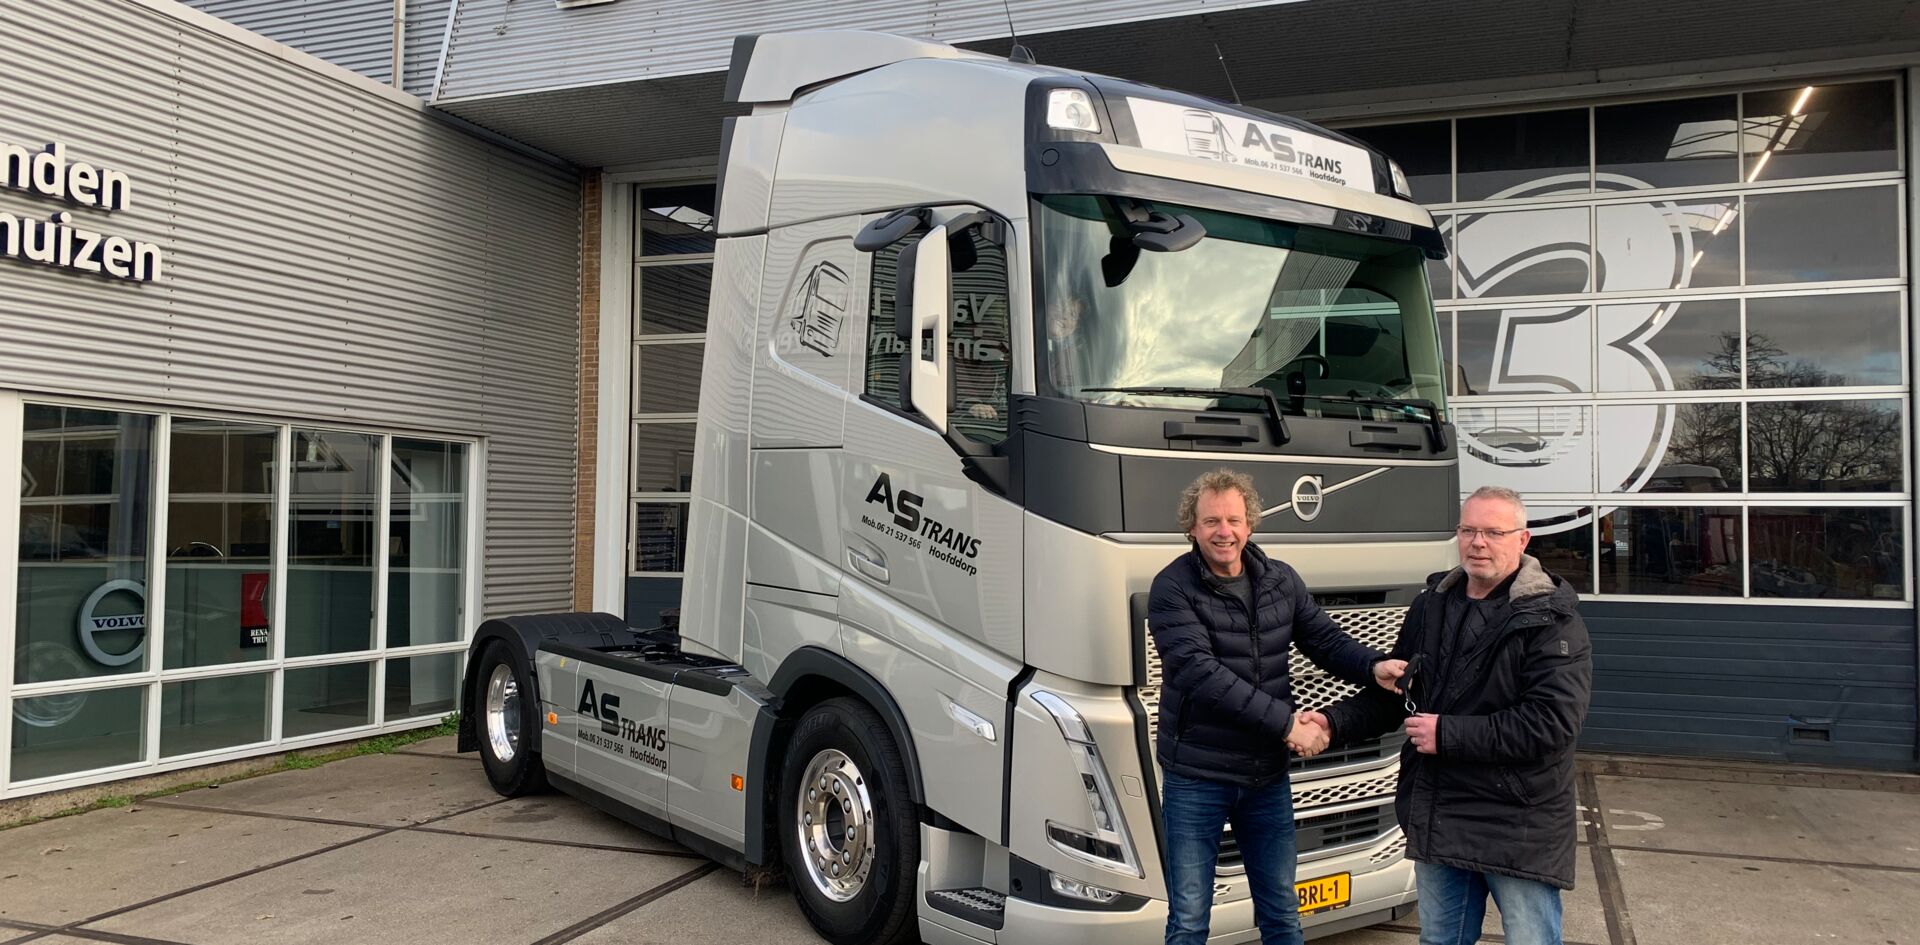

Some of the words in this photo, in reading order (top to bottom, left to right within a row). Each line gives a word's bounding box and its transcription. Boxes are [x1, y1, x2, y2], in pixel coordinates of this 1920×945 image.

[0, 142, 131, 210] nden
[1309, 170, 1346, 186] Hoofddorp
[885, 527, 894, 537] 21
[894, 530, 908, 543] 537
[908, 537, 922, 550] 566
[928, 545, 977, 576] Hoofddorp
[920, 517, 982, 559] TRANS
[620, 717, 667, 751] TRANS
[603, 738, 614, 751] 537
[614, 742, 624, 754] 566
[630, 746, 667, 772] Hoofddorp
